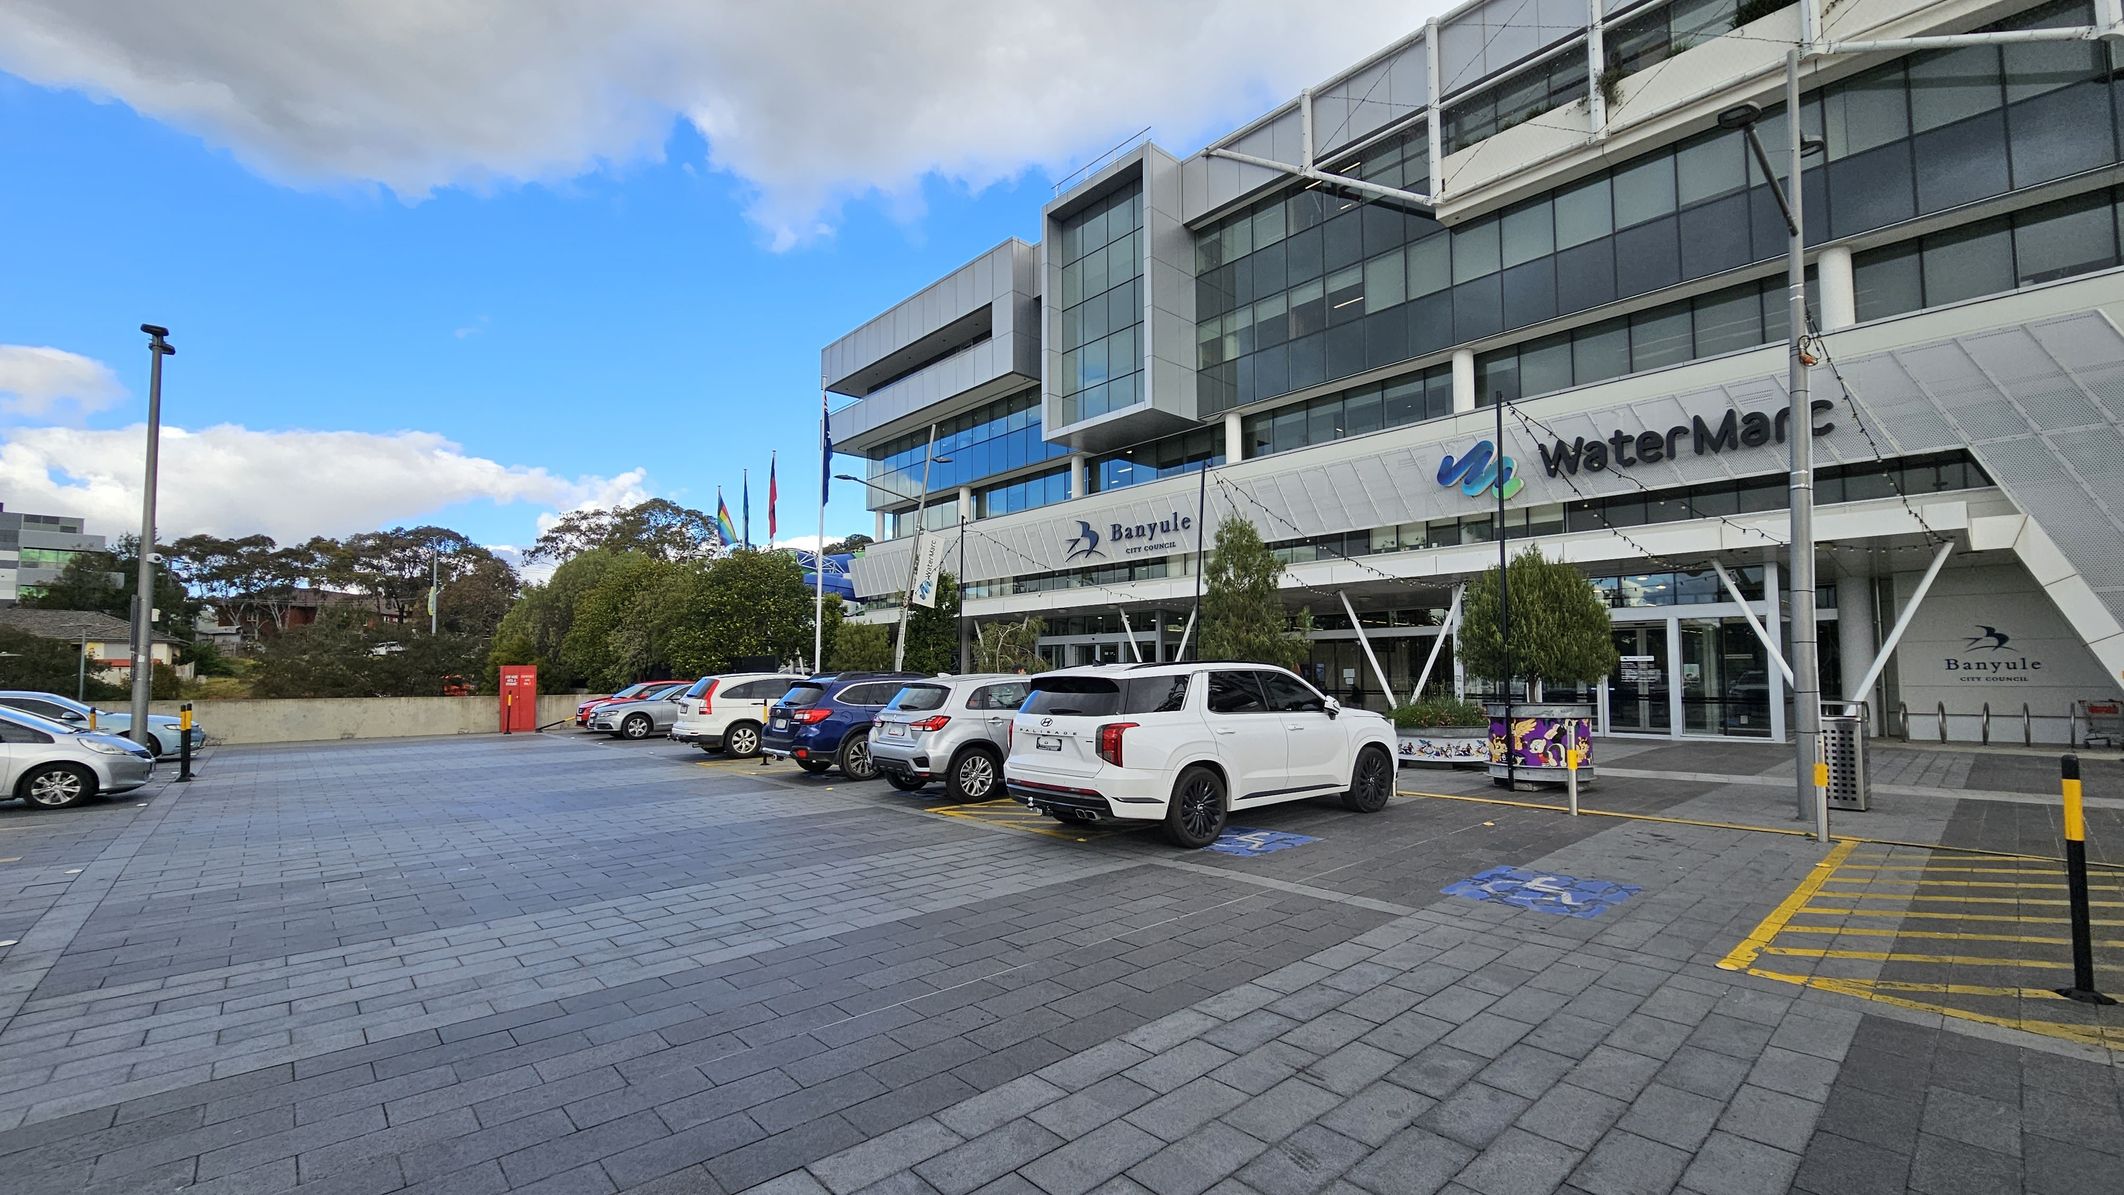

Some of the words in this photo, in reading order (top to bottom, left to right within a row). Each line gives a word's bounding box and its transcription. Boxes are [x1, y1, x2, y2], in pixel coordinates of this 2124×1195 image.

[1538, 399, 1836, 478] WaterMarc
[1110, 512, 1191, 541] Banyule
[925, 540, 937, 579] WaterMarc
[1126, 546, 1142, 554] CITY
[1144, 541, 1177, 552] COUNCIL
[1944, 657, 2042, 674] Banyule
